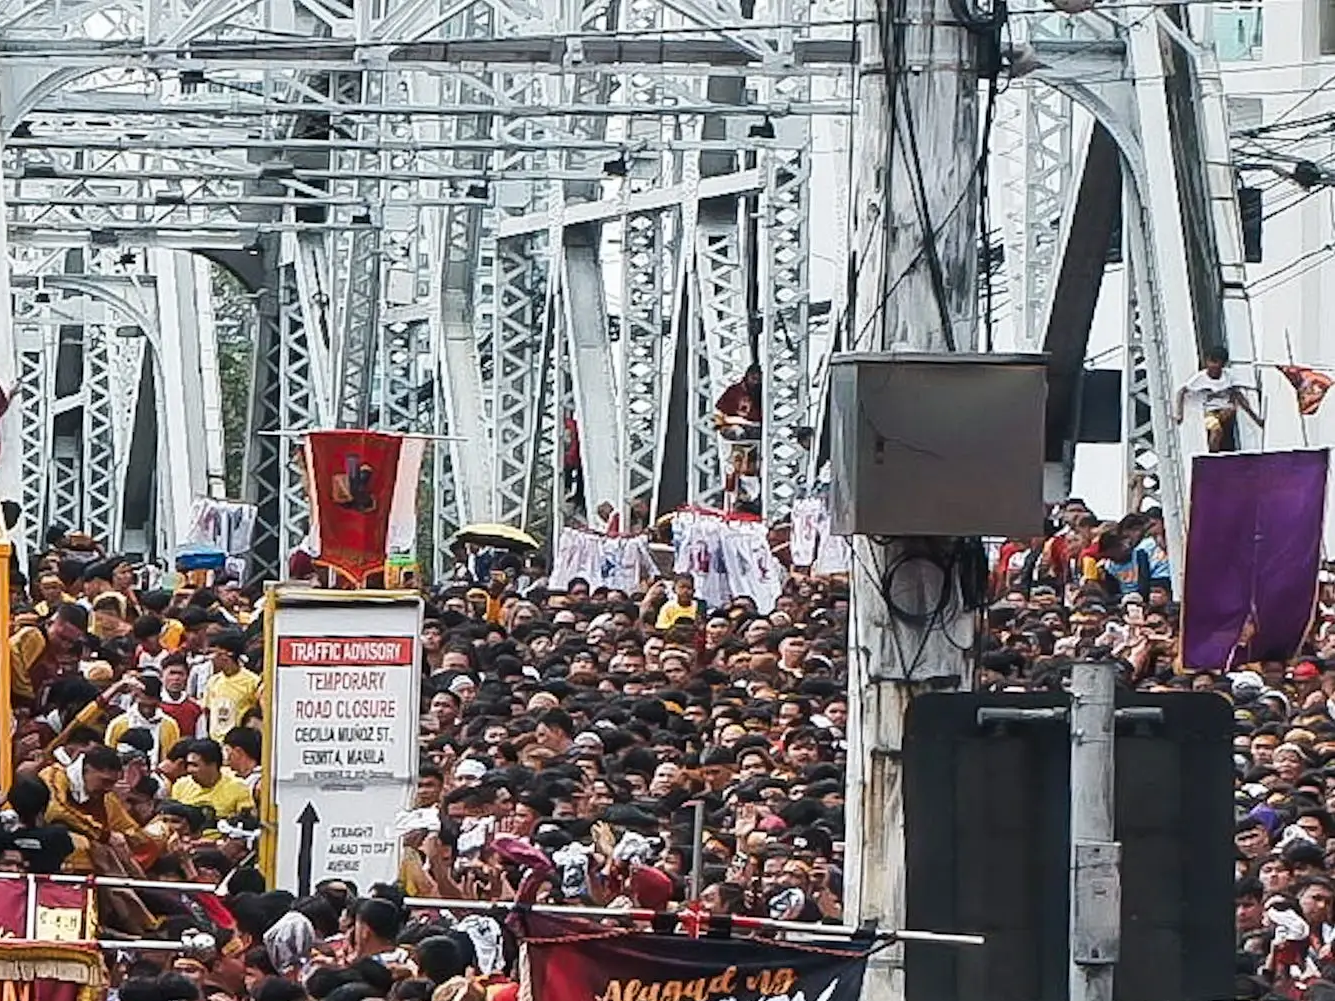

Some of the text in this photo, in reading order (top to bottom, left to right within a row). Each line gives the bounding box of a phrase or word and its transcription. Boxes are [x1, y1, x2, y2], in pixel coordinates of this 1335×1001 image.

[290, 641, 403, 661] TRAFFIC ADVISORY
[306, 672, 386, 690] TEMPORARY
[296, 700, 396, 719] ROAD CLOSURE
